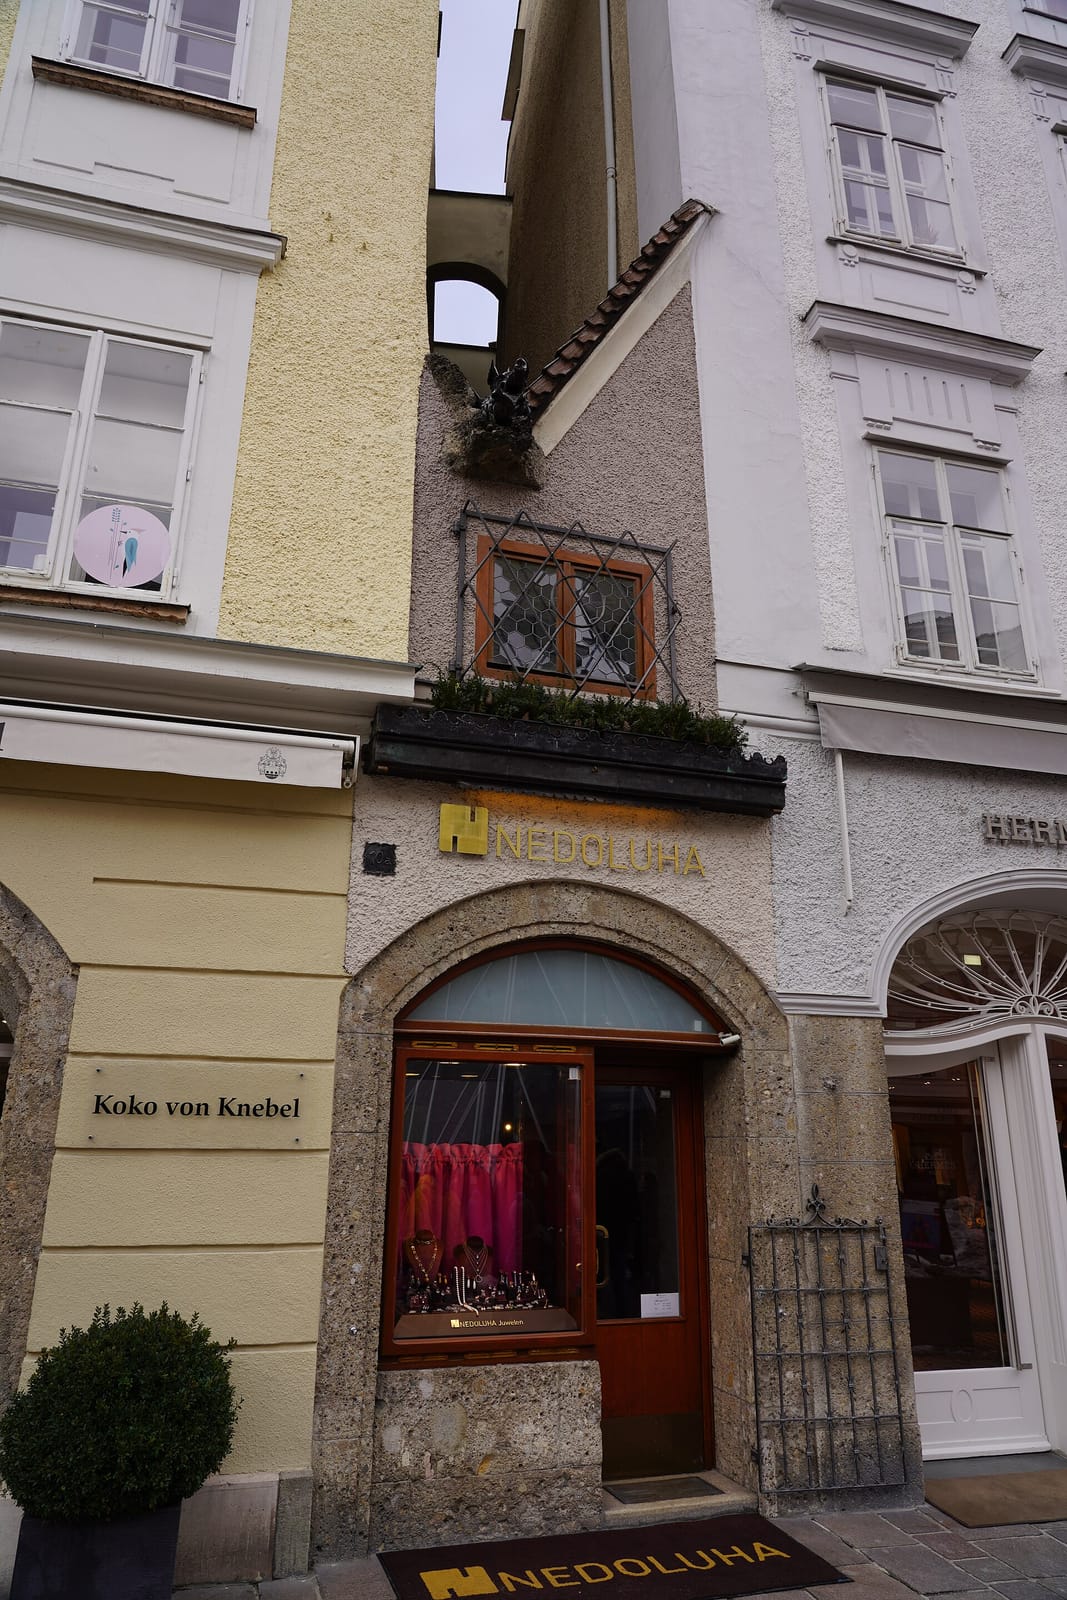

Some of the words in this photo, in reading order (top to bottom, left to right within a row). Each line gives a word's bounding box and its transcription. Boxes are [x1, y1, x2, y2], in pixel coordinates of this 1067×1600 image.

[495, 824, 706, 878] NEDOLUHA
[92, 1094, 158, 1116] Koko
[165, 1101, 210, 1117] von
[217, 1096, 300, 1118] Knebel
[460, 1319, 497, 1328] NEDOLUHA
[497, 1541, 791, 1593] NEDOLUHA
